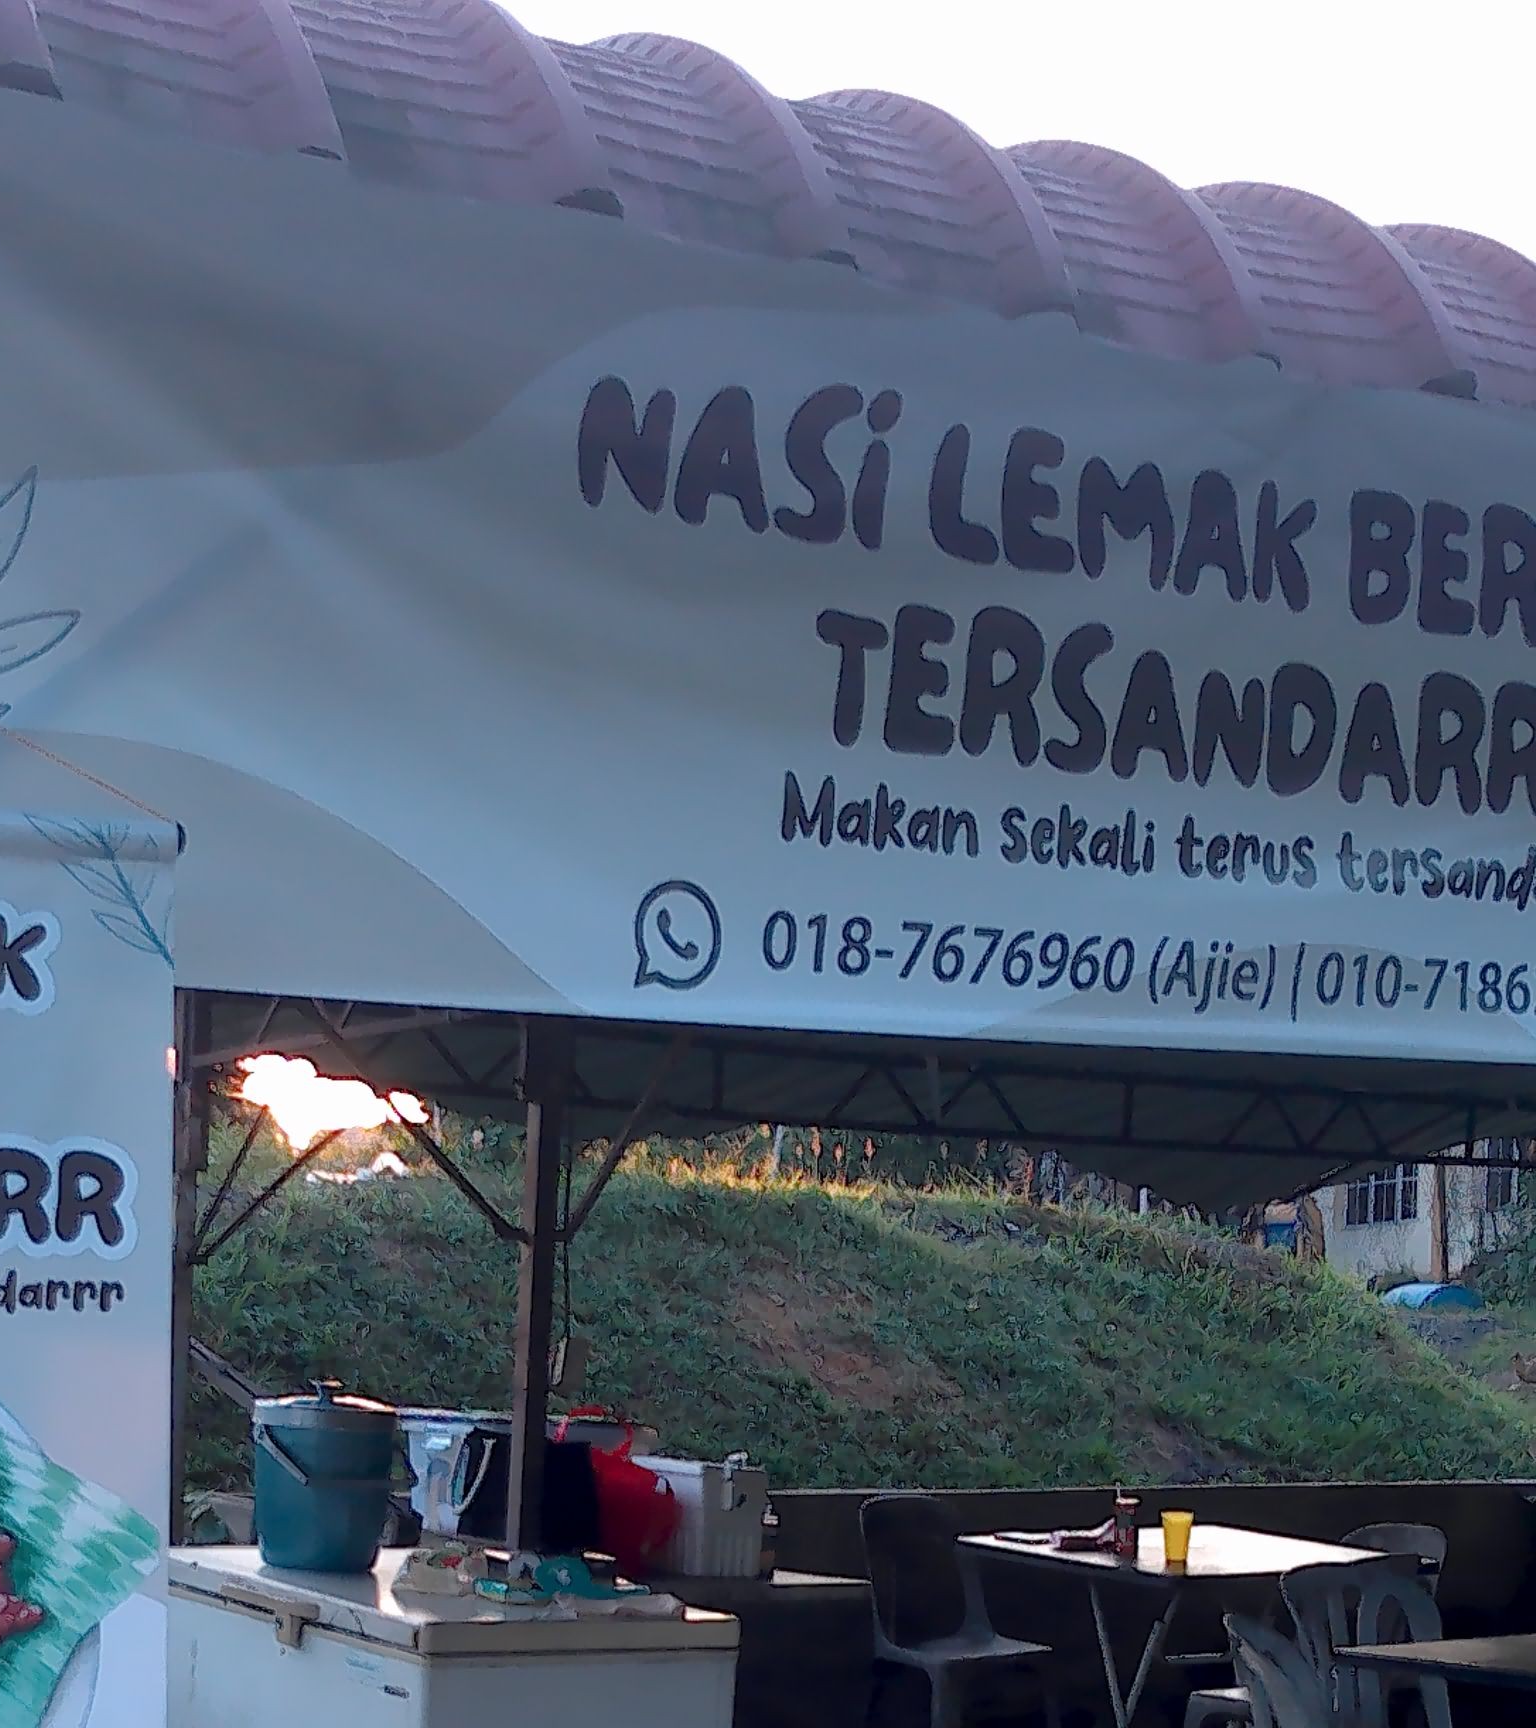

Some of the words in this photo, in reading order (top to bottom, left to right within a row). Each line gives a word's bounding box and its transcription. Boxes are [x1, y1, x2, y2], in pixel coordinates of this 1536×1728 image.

[928, 423, 1318, 614] LEMAK
[780, 769, 979, 859] Makan
[1175, 813, 1318, 890] terus
[762, 910, 1135, 993] 018-7676960
[1149, 935, 1276, 1014] (Ajie)
